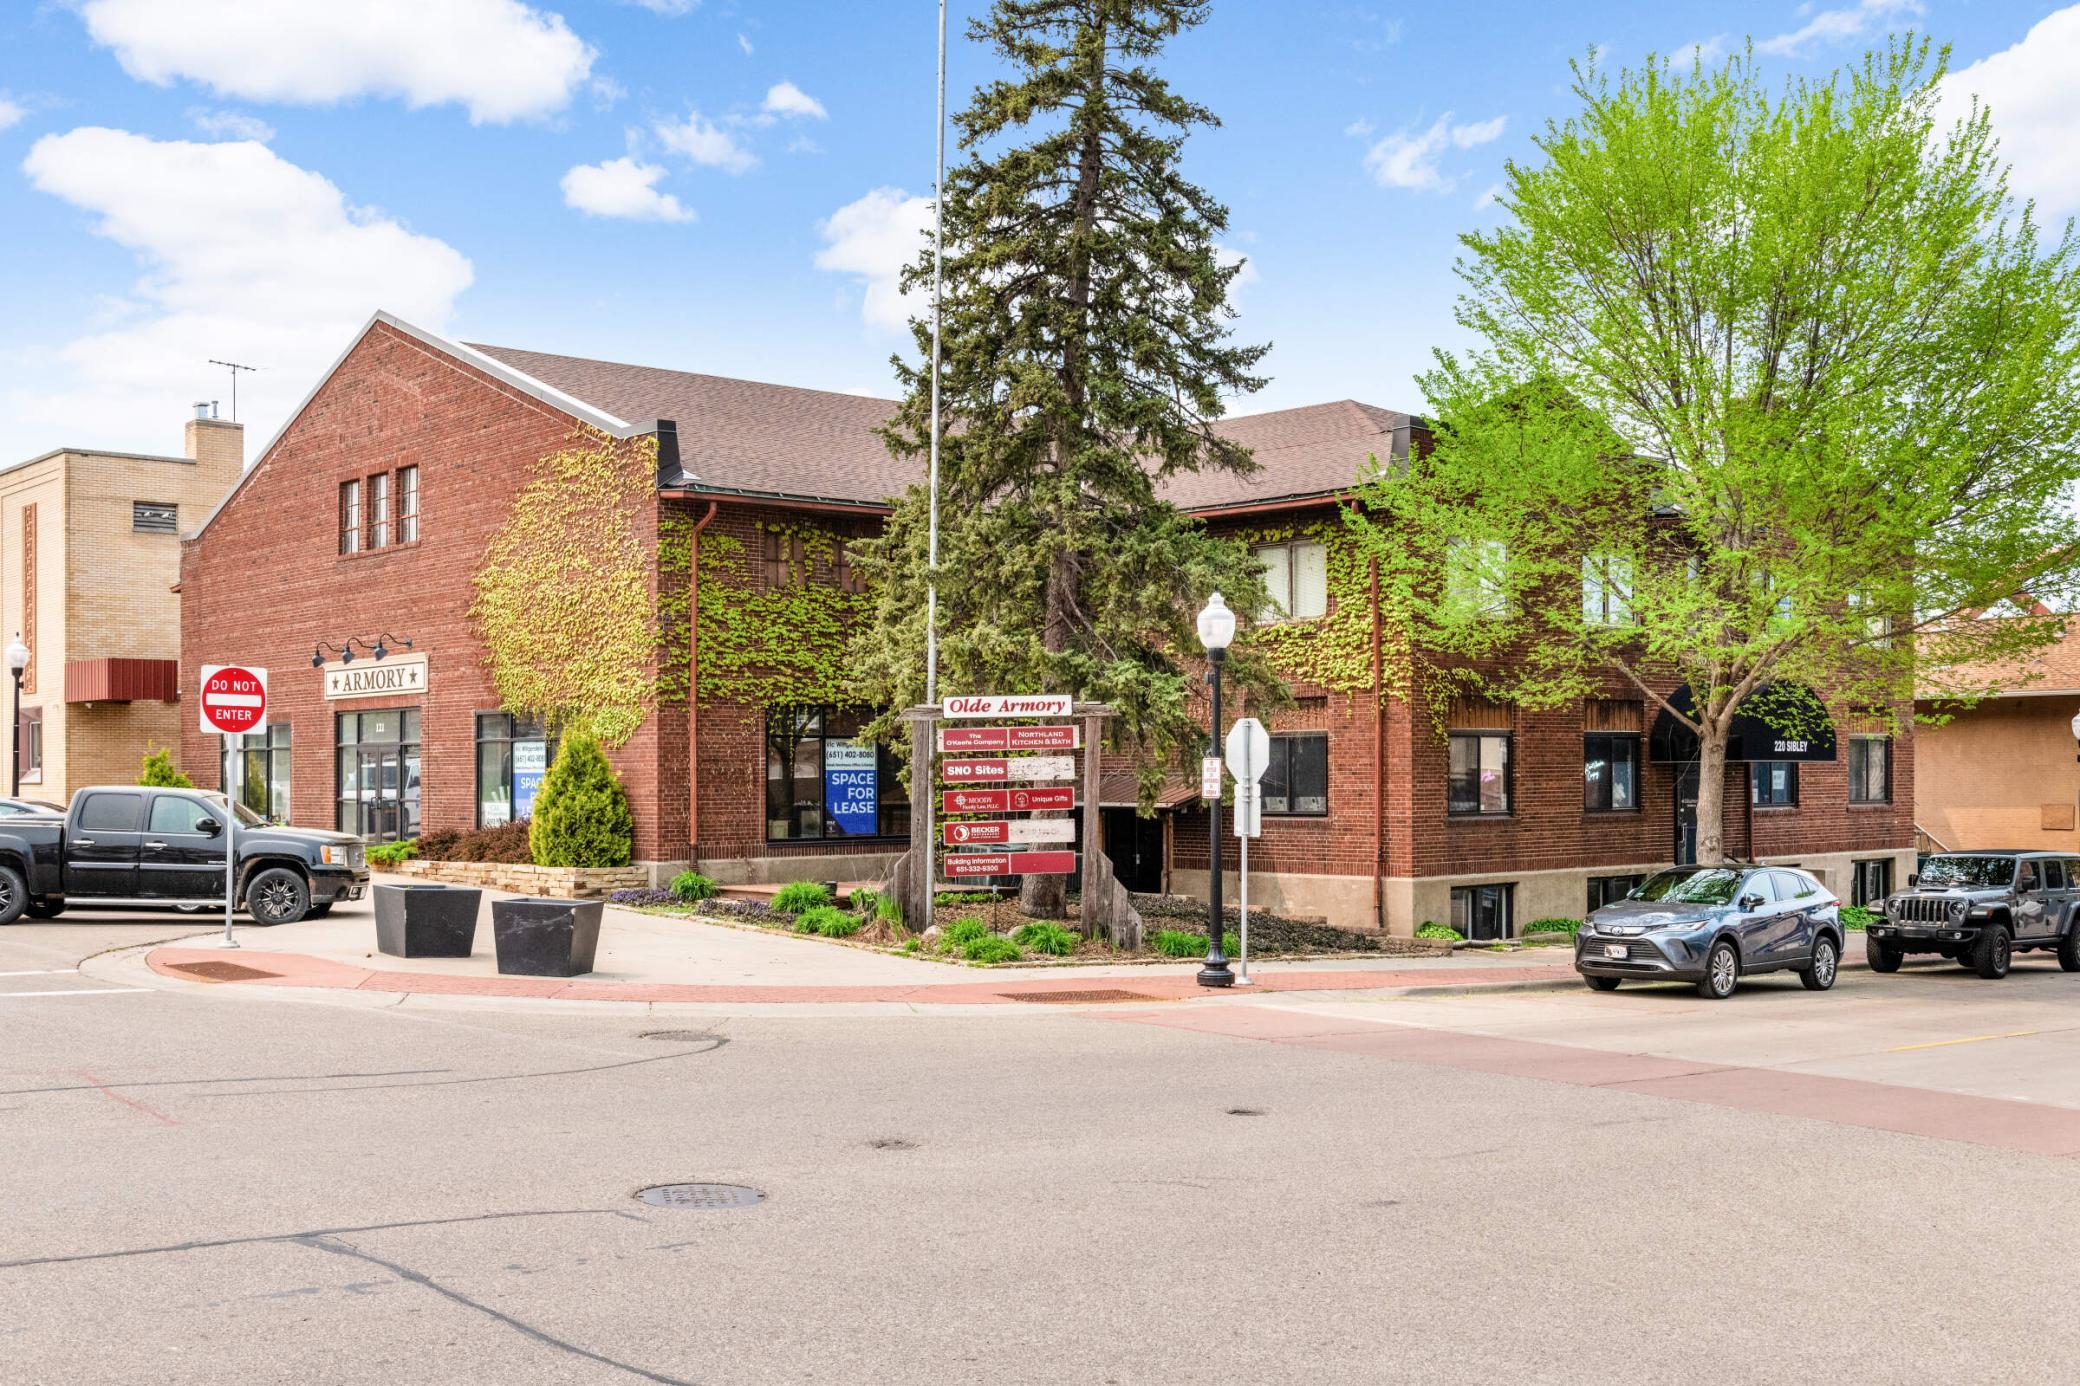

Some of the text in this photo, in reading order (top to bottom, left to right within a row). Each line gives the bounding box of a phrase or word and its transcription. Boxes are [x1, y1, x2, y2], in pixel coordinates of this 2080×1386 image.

[211, 679, 257, 692] DO NOT
[342, 668, 406, 692] ARMORY
[949, 698, 1066, 715] Olde Armory
[215, 708, 252, 721] ENTER
[1774, 740, 1808, 752] 220 SIBLEY
[826, 750, 844, 760] (651)
[947, 765, 1005, 776] SNO Sites
[520, 776, 543, 790] SPAC
[831, 772, 875, 785] SPACE
[847, 787, 875, 800] FOR
[834, 801, 875, 814] LEASE
